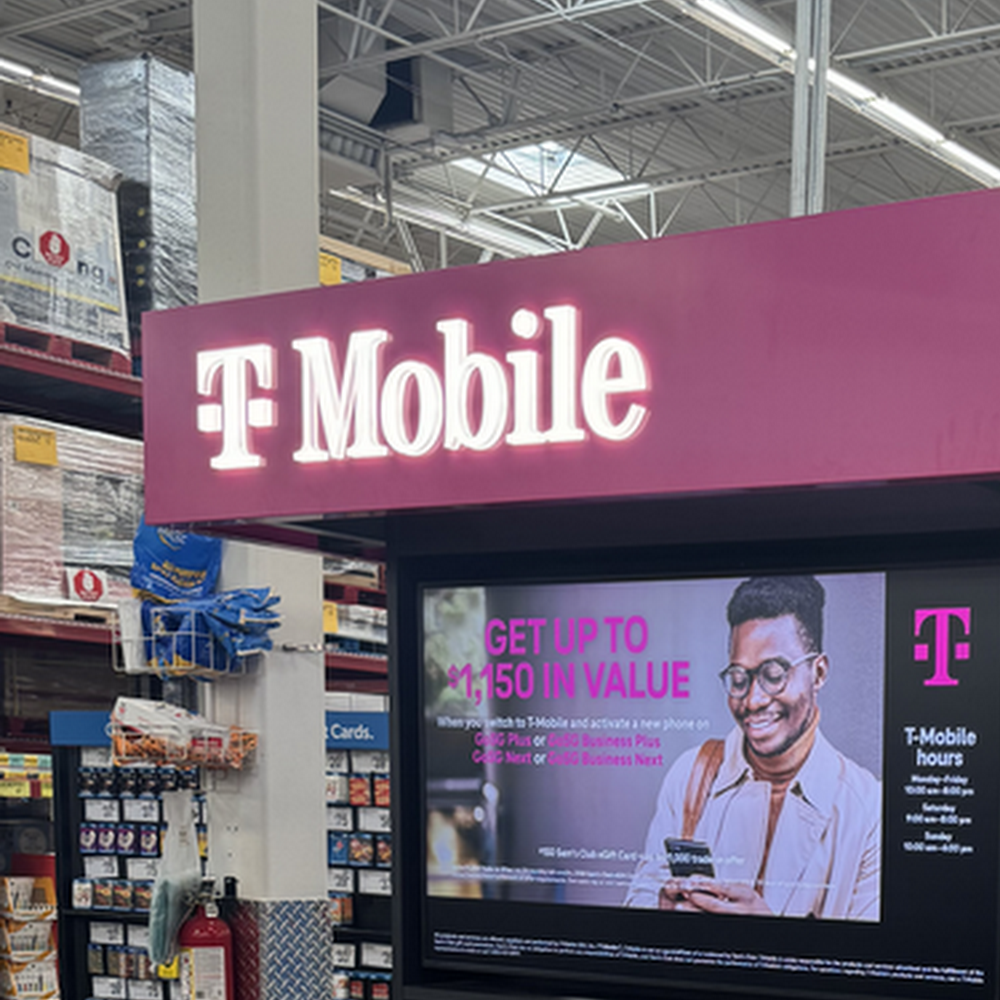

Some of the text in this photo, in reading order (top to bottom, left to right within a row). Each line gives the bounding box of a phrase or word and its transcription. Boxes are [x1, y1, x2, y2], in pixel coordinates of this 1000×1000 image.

[291, 305, 651, 463] Mobile
[484, 616, 649, 655] GET UP TO
[914, 607, 971, 686] T
[447, 661, 690, 705] $1,150 IN VALUE
[330, 723, 375, 740] Cards.
[533, 734, 546, 747] or
[582, 733, 632, 749] Business
[635, 733, 661, 749] Plus
[904, 726, 977, 746] T-Mobile
[533, 752, 546, 766] or
[582, 750, 632, 767] Business
[635, 752, 663, 767] Next
[916, 747, 964, 767] hours
